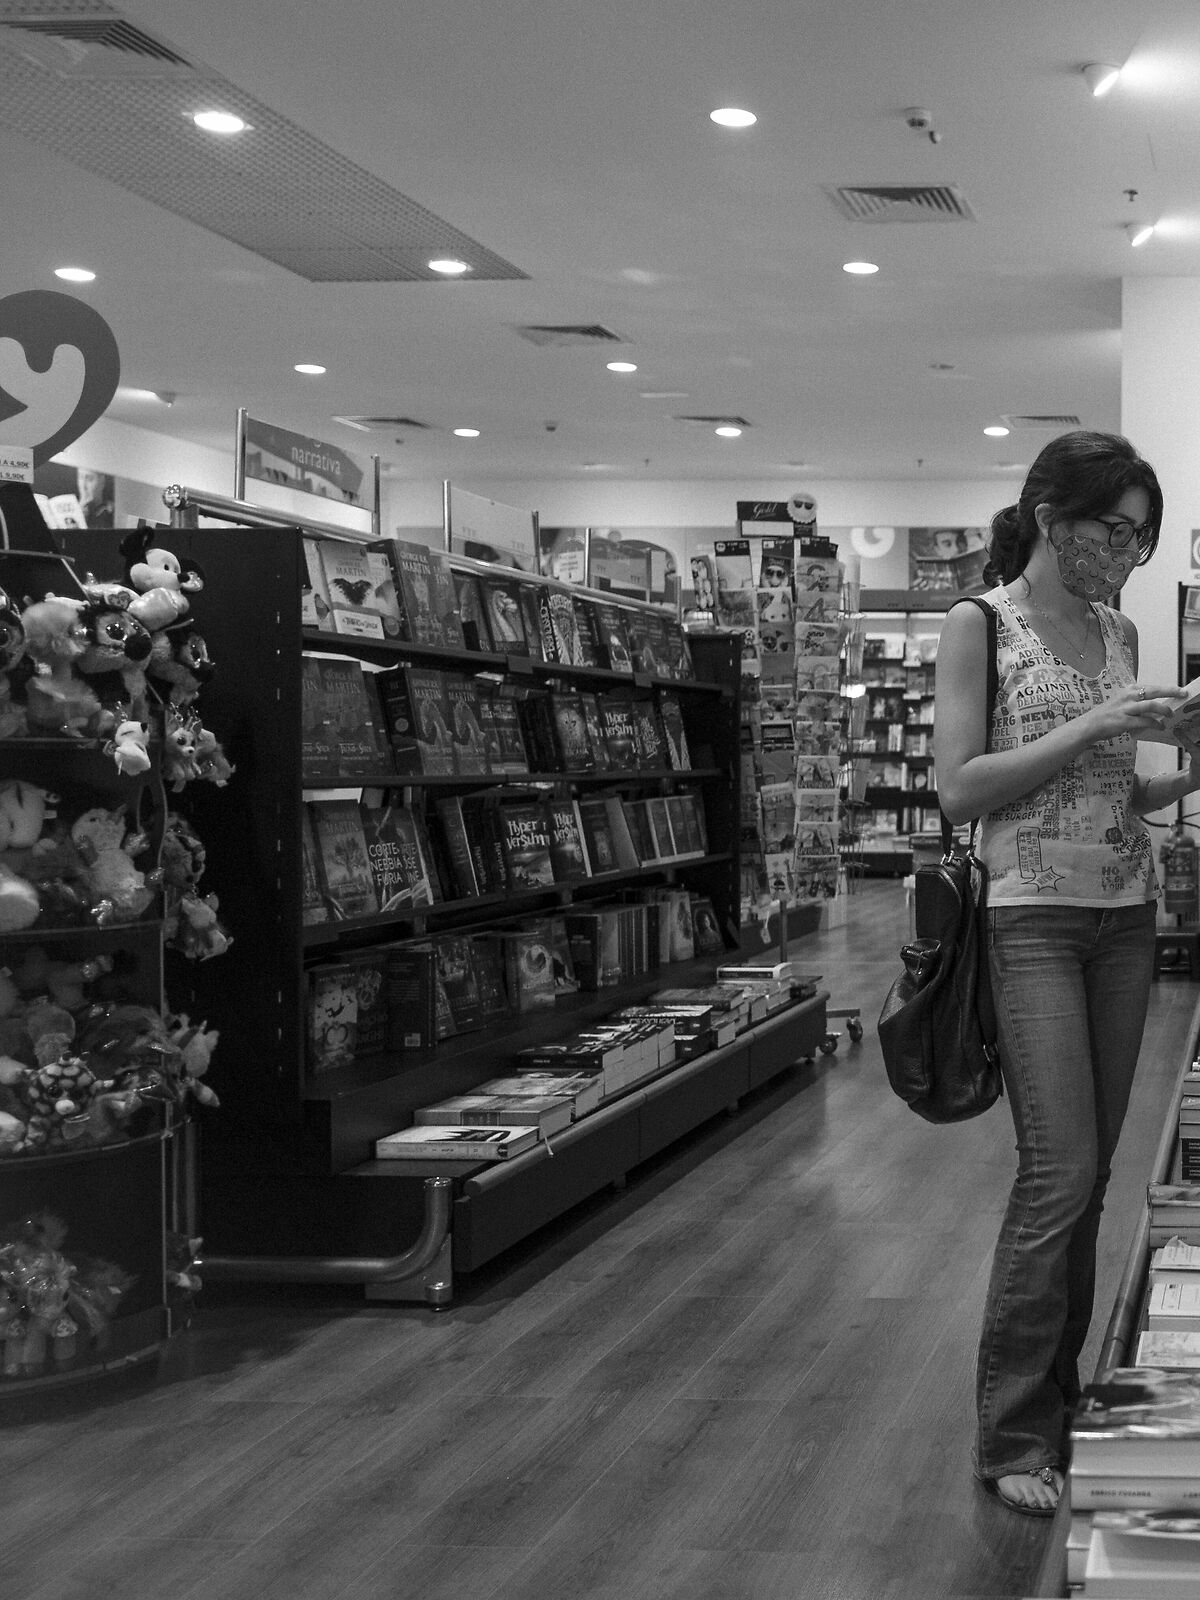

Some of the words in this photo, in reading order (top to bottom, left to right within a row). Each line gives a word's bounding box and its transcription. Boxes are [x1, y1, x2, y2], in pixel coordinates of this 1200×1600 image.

[292, 446, 341, 475] narrativa
[335, 567, 367, 578] MARTIN
[402, 561, 432, 575] MARTIN
[1009, 656, 1052, 672] PLASTIC
[1016, 683, 1072, 700] AGAINST
[1017, 691, 1076, 708] DEPRESSION
[1020, 709, 1055, 724] NEW
[1004, 809, 1043, 821] SURGERY
[1041, 798, 1055, 840] ICEBERG
[369, 842, 400, 857] CORTE
[370, 856, 403, 872] NEBBIA
[376, 873, 403, 886] FURIA
